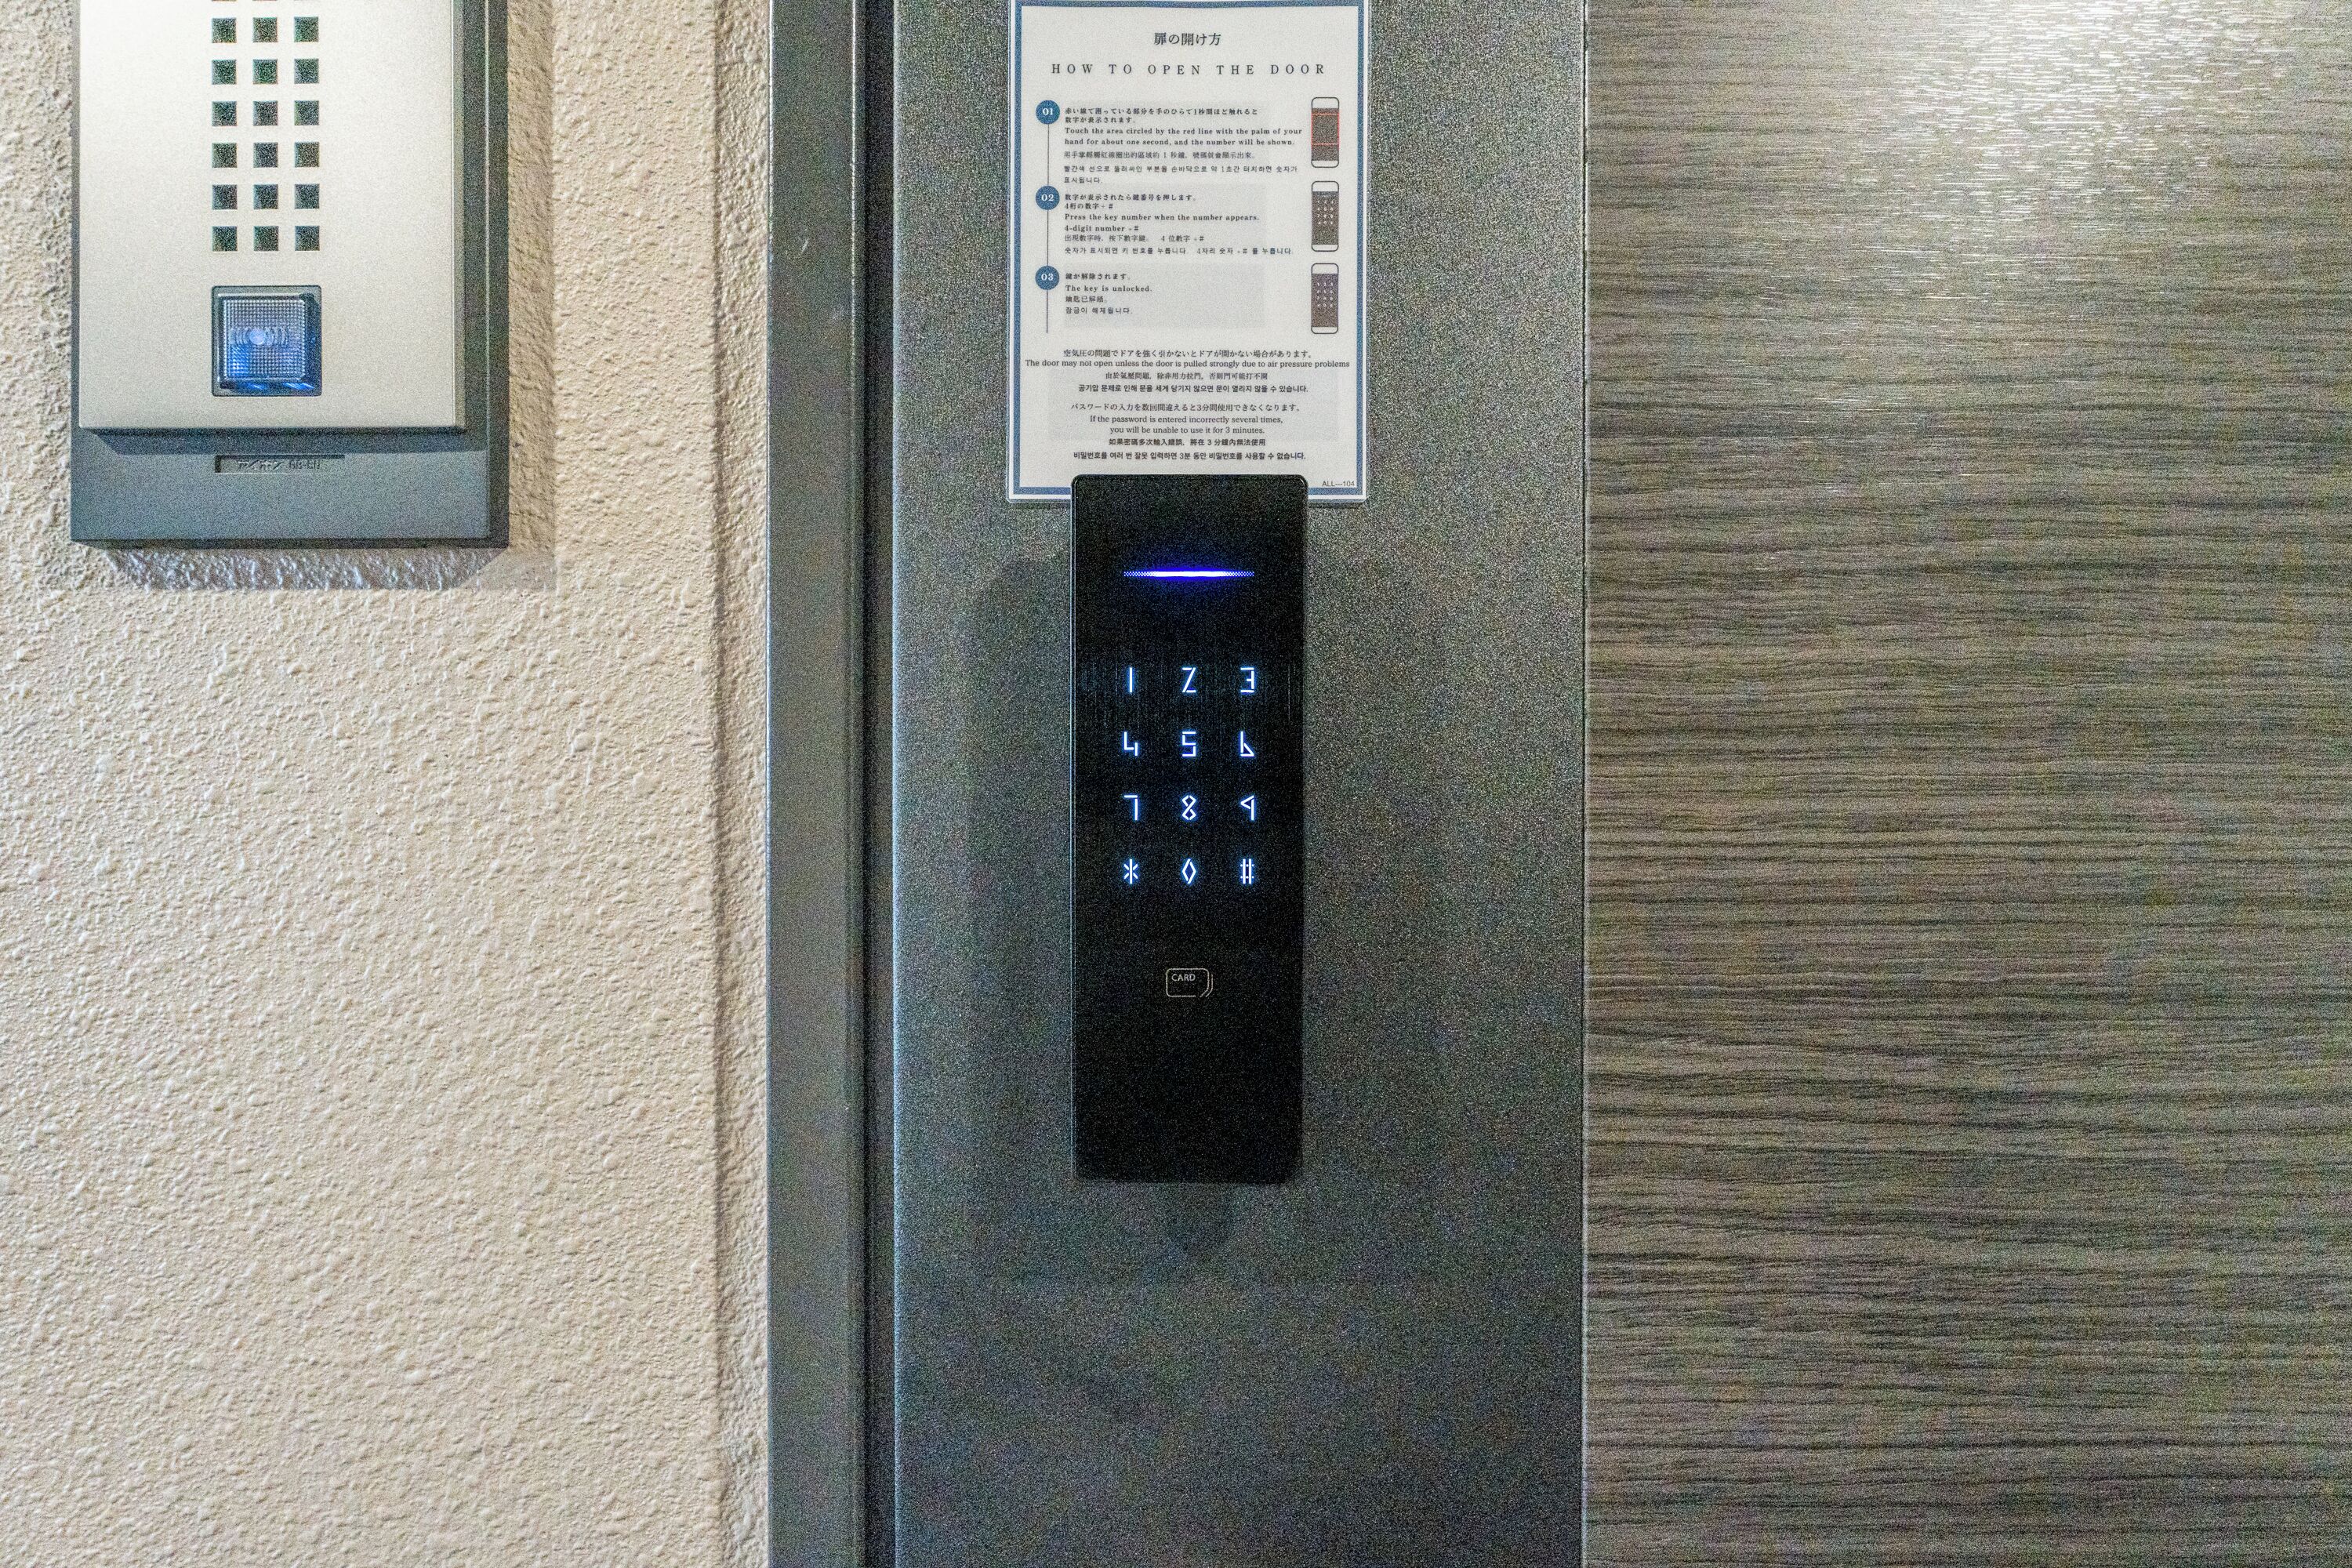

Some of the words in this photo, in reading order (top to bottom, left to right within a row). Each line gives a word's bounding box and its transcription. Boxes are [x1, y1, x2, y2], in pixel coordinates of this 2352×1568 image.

[1154, 32, 1221, 46] 扉の開け方
[1051, 64, 1093, 74] HOW
[1109, 64, 1132, 74] TO
[1148, 64, 1200, 75] OPEN
[1216, 64, 1254, 75] THE
[1271, 64, 1323, 74] DOOR
[1042, 107, 1054, 117] 01
[1041, 194, 1054, 203] 02
[1041, 272, 1054, 282] 03
[1128, 666, 1134, 693] 1
[1181, 666, 1196, 693] 2
[1240, 666, 1255, 693] 3
[1123, 731, 1138, 757] 4
[1181, 731, 1196, 757] 5
[1240, 731, 1255, 757] 6
[1123, 794, 1138, 821] 7
[1181, 794, 1197, 821] 8
[1240, 795, 1255, 821] 9
[1181, 858, 1197, 884] 0
[1240, 858, 1255, 884] #
[1171, 973, 1196, 982] CARD
